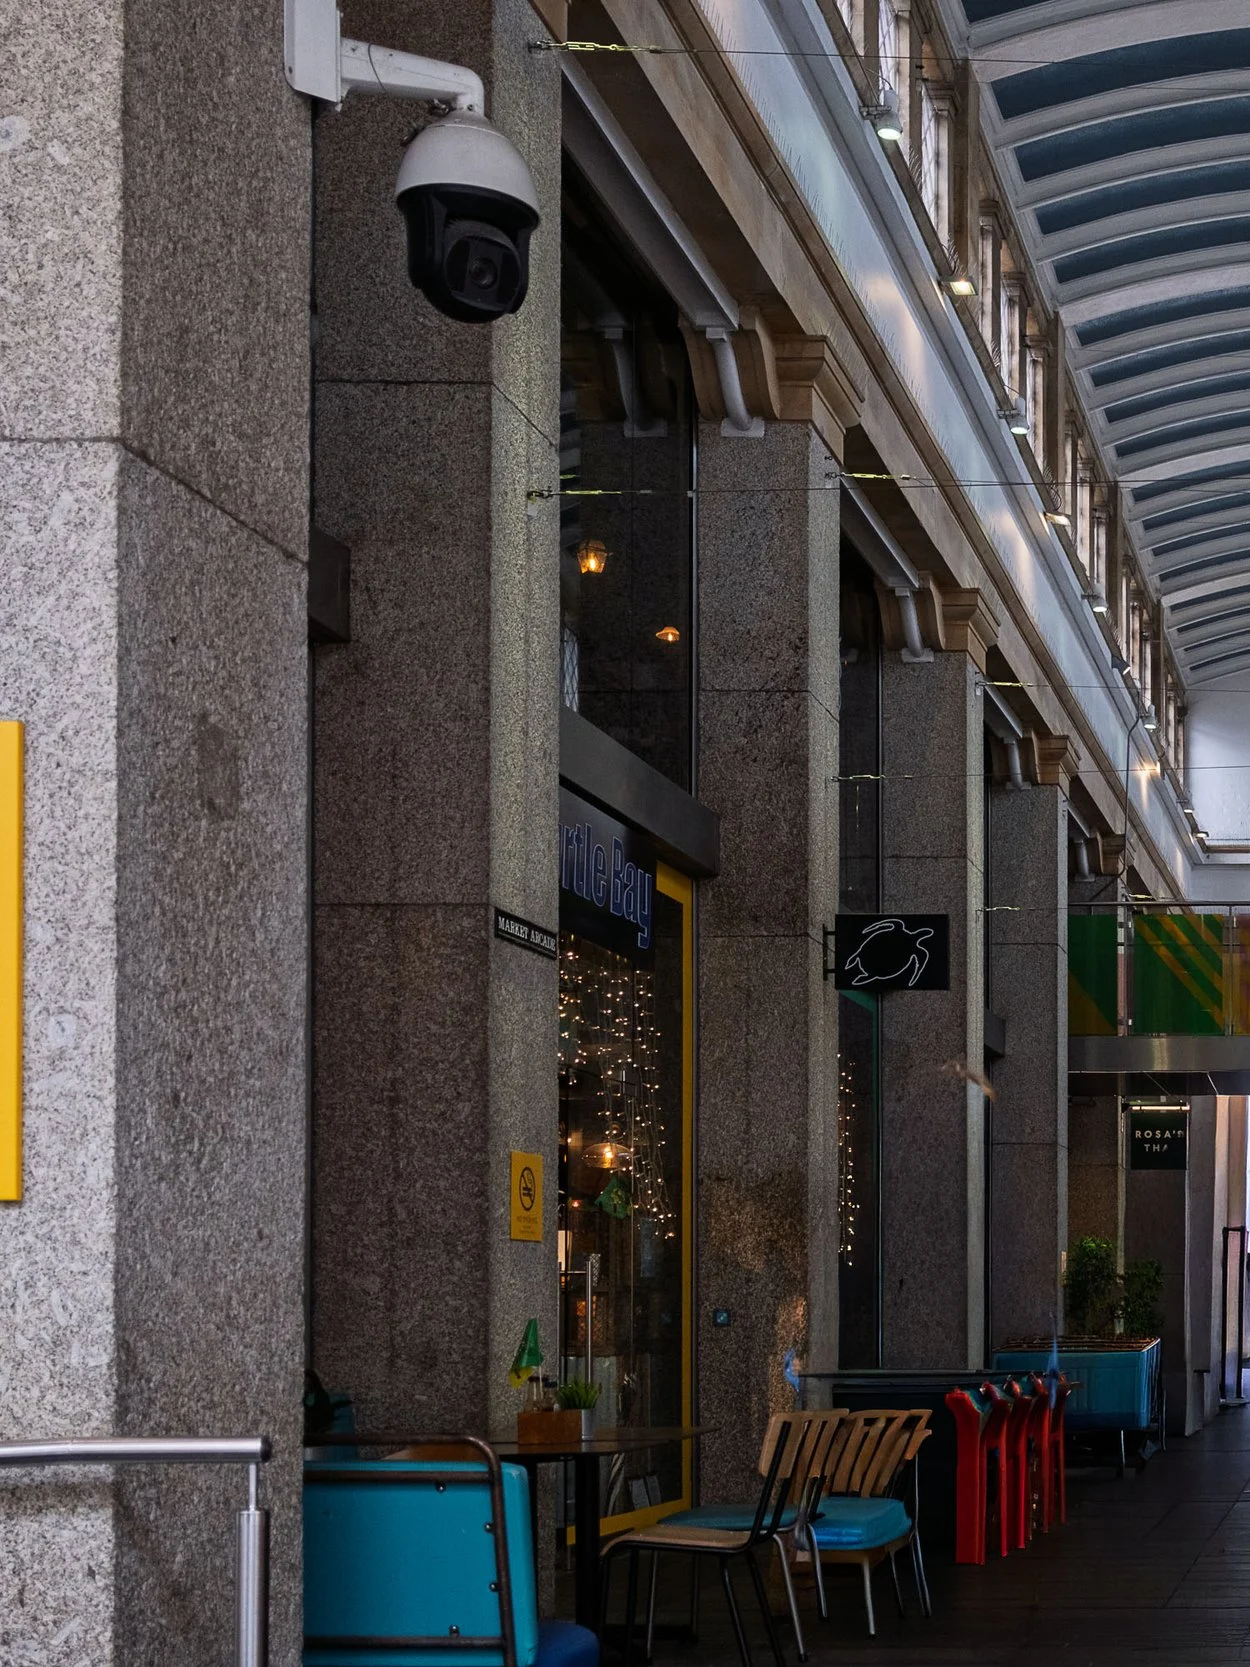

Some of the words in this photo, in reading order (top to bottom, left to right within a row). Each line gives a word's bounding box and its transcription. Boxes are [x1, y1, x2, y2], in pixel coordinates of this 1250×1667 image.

[559, 823, 608, 907] rtle
[610, 836, 653, 949] Bay
[498, 916, 529, 939] MARKET
[530, 929, 556, 951] ARCADE
